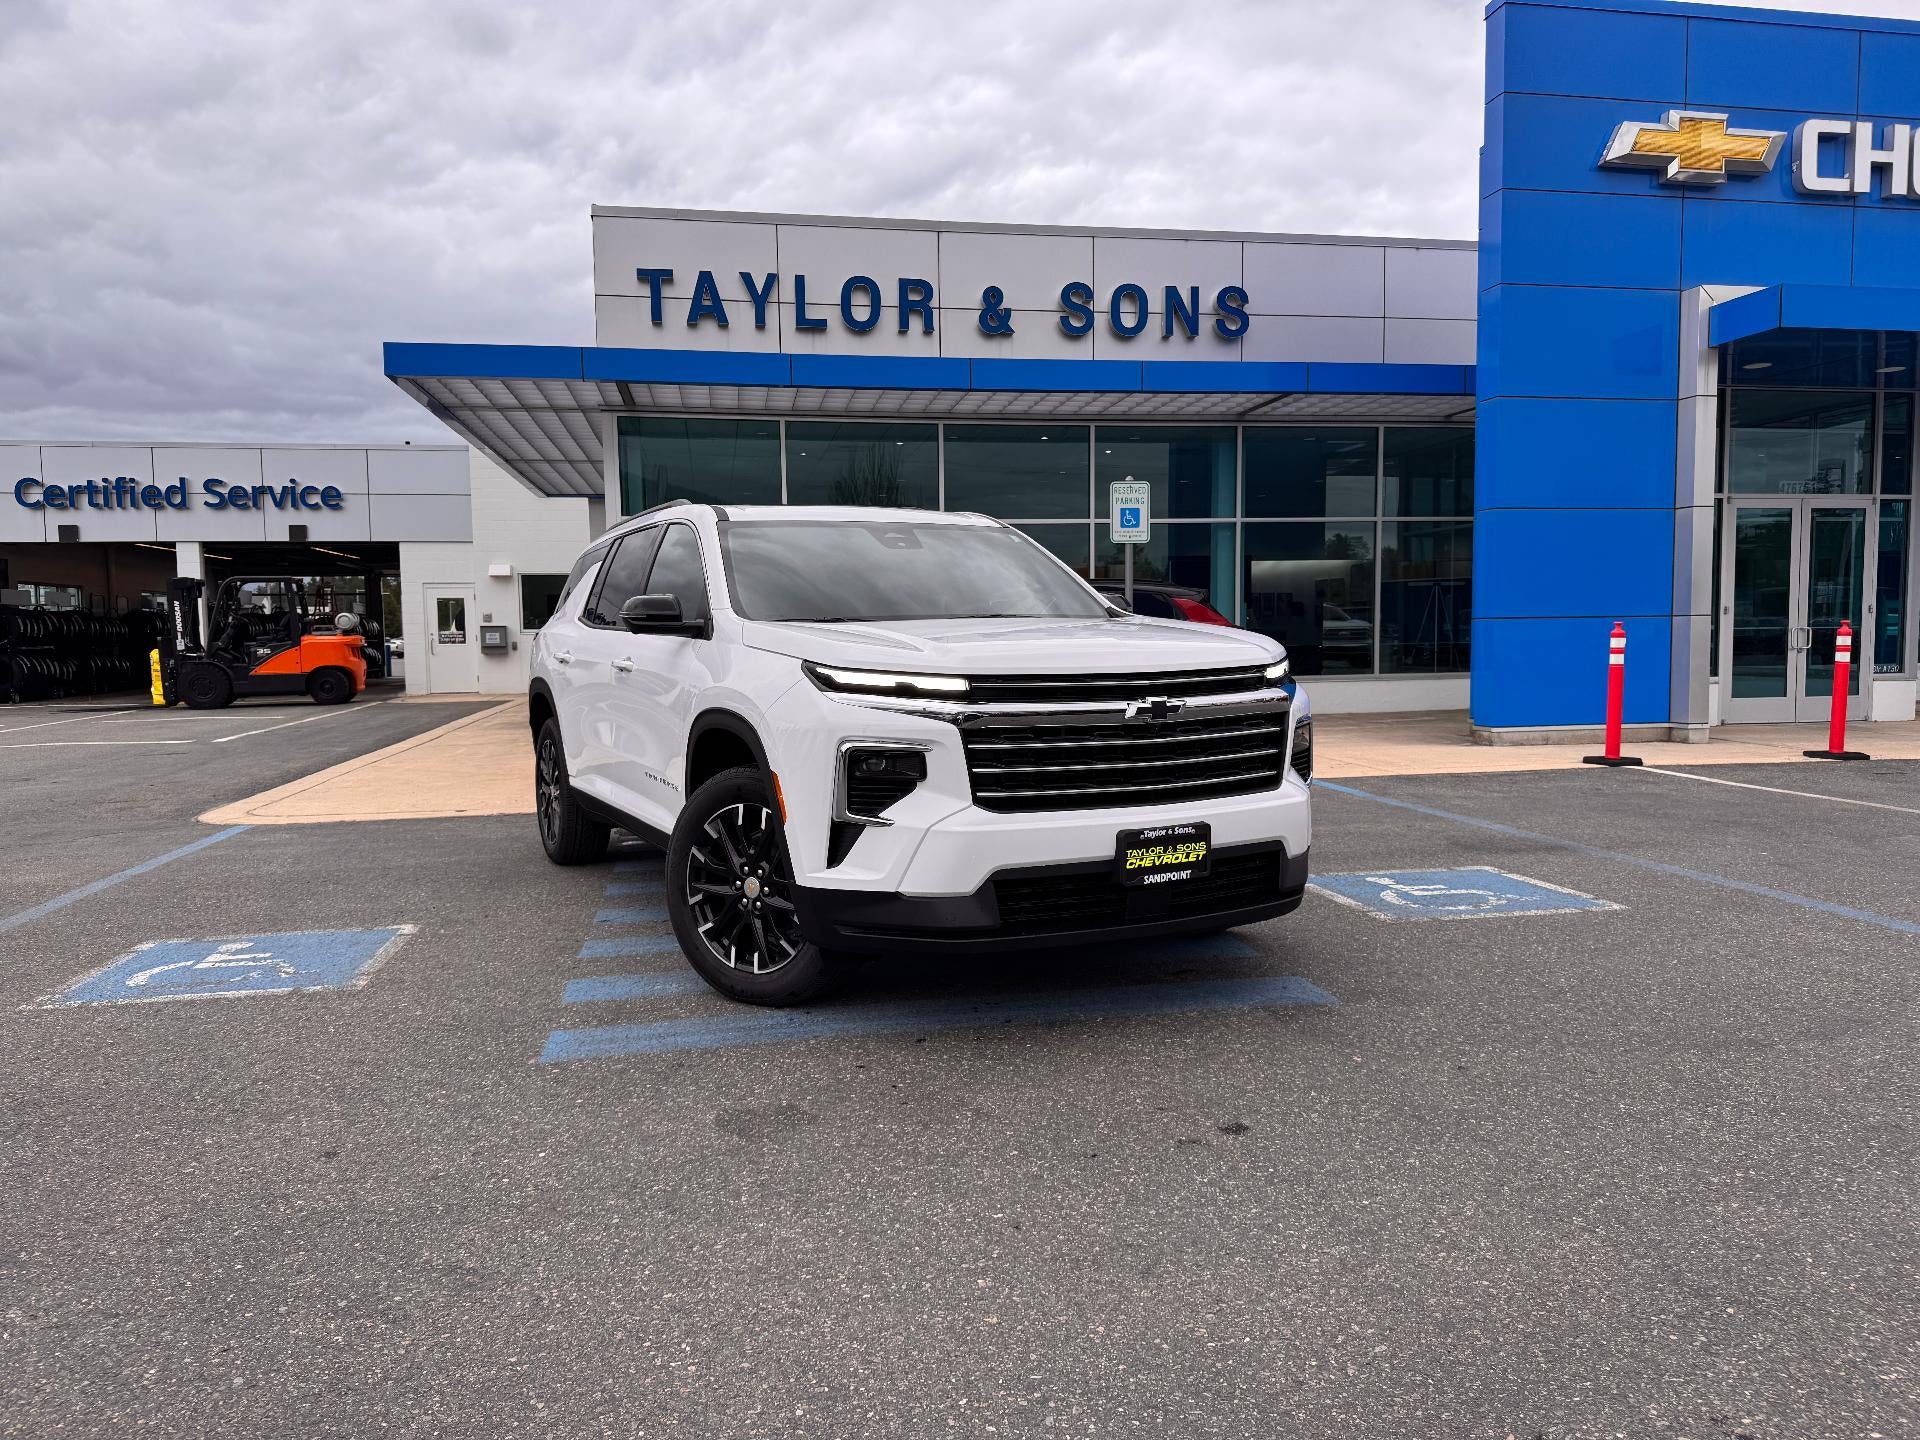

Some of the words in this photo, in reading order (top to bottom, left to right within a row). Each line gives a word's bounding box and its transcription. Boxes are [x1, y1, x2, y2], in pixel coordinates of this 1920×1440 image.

[1792, 118, 1920, 198] CH
[636, 267, 935, 334] TAYLOR
[978, 285, 1016, 337] &
[1058, 281, 1250, 339] SONS
[14, 476, 188, 510] Certified
[202, 478, 344, 510] Service
[1114, 486, 1146, 494] RESERVED
[1144, 828, 1166, 839] Taylor
[1174, 826, 1192, 834] Sons
[1126, 846, 1164, 857] TAYLOR
[1166, 845, 1174, 855] &
[1176, 842, 1206, 852] SONS
[1126, 852, 1206, 869] CHEVROLET
[1144, 870, 1192, 884] SANDPOINT
